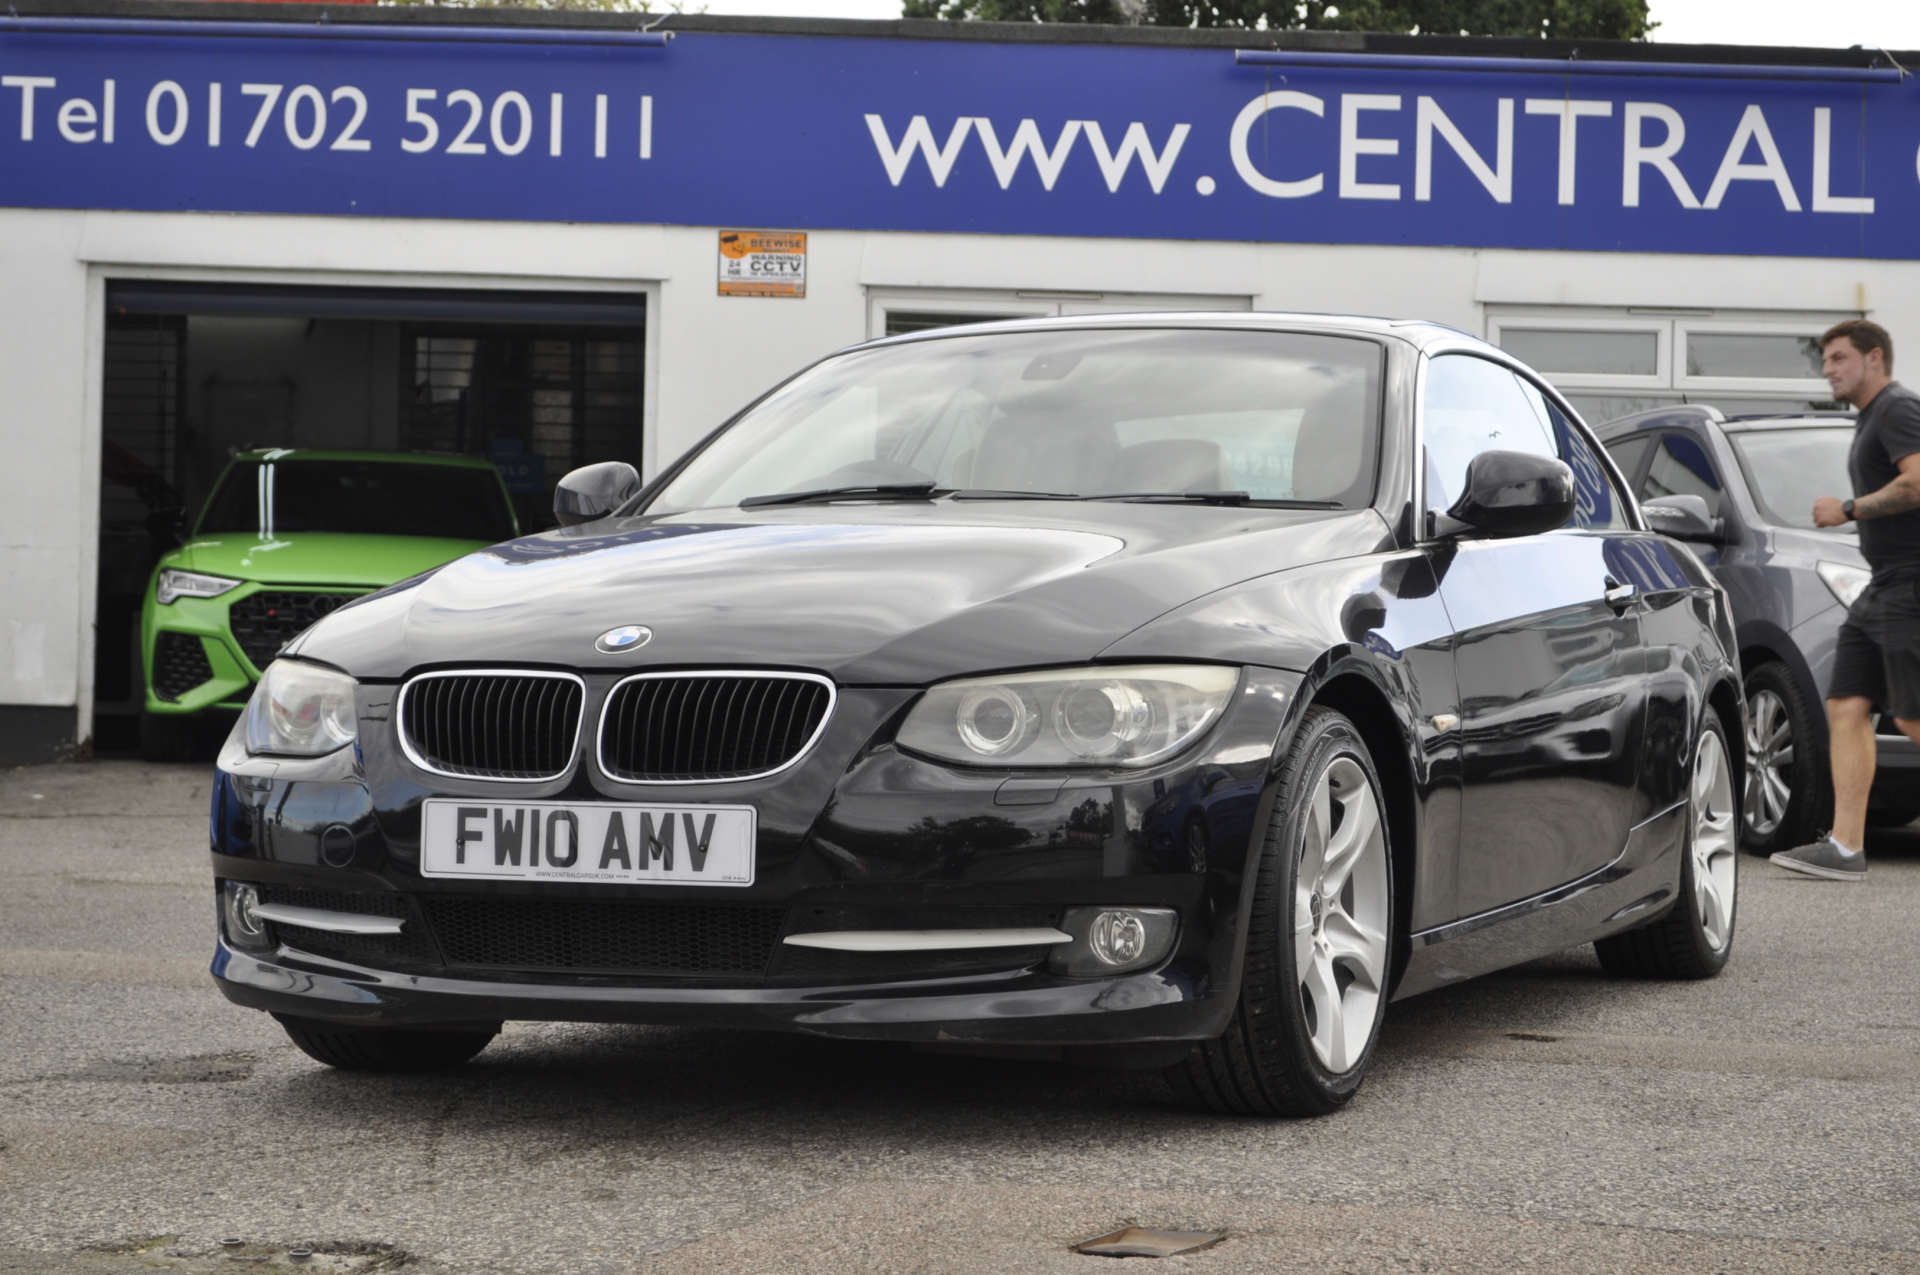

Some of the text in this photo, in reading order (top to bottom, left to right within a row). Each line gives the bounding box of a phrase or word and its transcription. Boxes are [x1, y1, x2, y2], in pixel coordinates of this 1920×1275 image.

[2, 77, 652, 158] Tel 01702 520111
[750, 238, 802, 249] BEEWISE
[750, 260, 801, 272] CCTV
[456, 807, 716, 871] FW10 AMV
